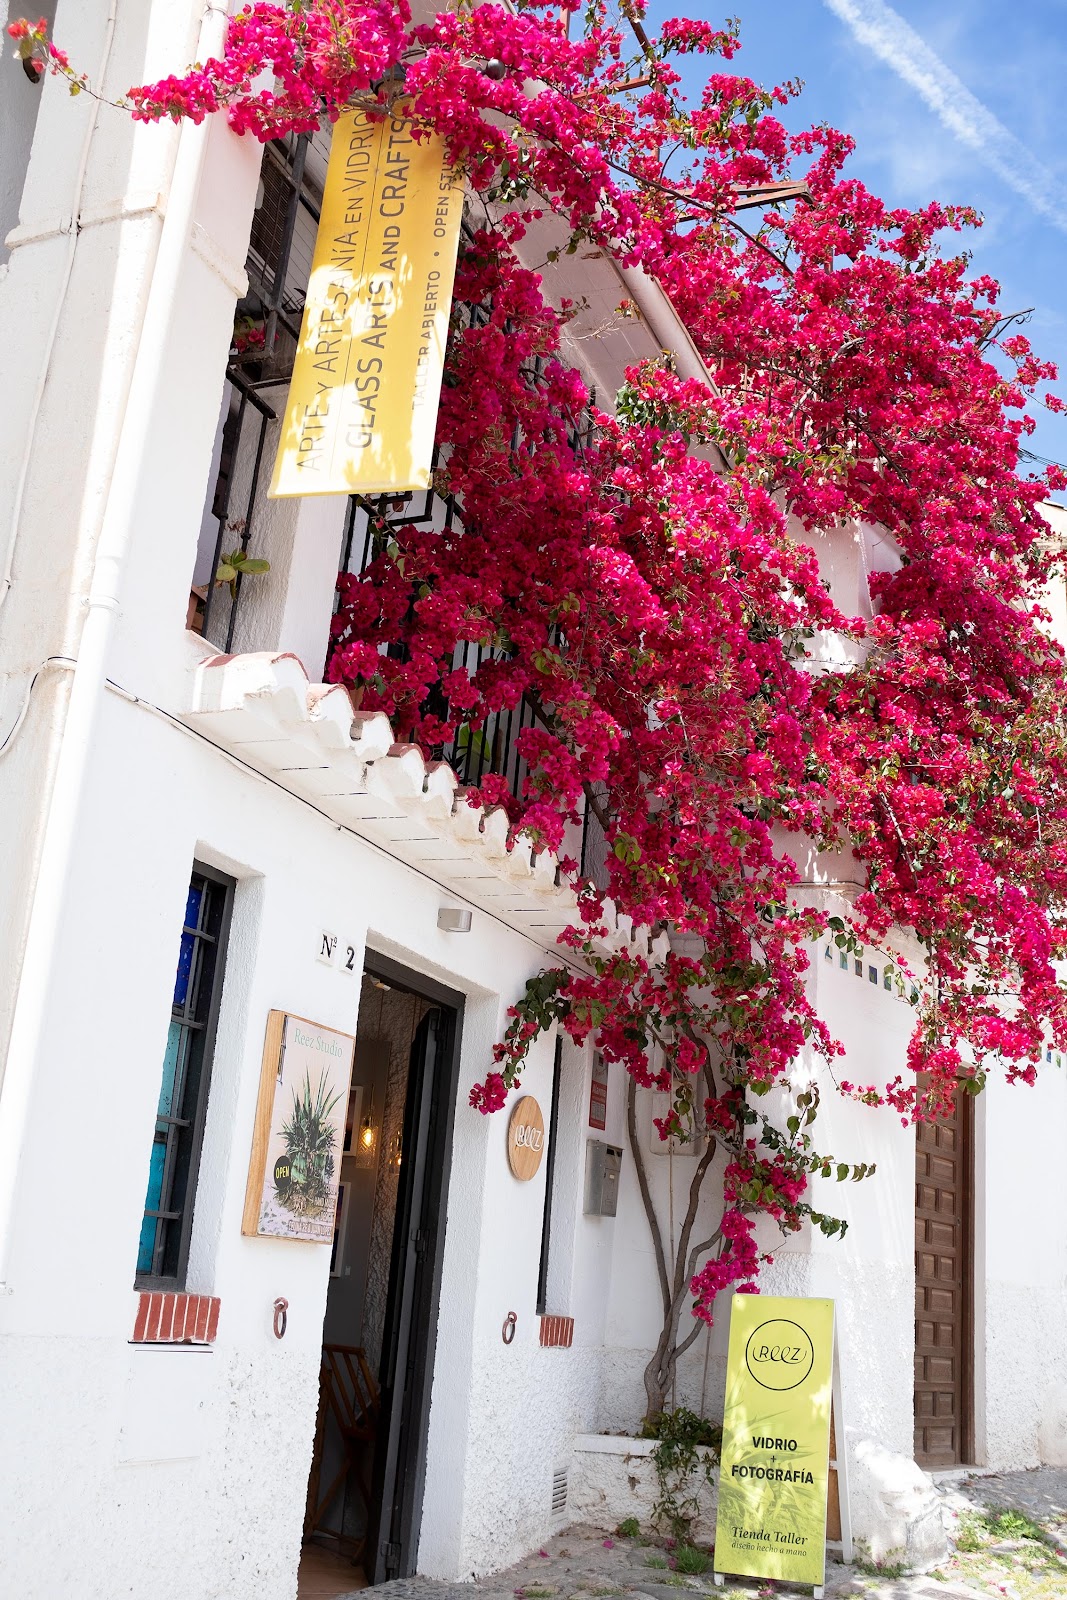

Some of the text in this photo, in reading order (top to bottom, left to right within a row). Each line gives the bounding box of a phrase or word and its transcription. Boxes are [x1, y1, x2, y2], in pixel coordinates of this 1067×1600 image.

[342, 111, 376, 192] VIDRIO
[344, 197, 364, 224] EN
[346, 119, 413, 448] GLASS ARTS AND CRAFTS
[412, 346, 430, 410] TALLER
[421, 271, 441, 339] ABIERTO
[434, 196, 450, 237] OPEN
[316, 381, 334, 395] Y
[296, 404, 330, 471] ARTE
[345, 946, 355, 970] 2
[294, 1028, 343, 1058] Reez Studio
[276, 1166, 290, 1179] OPEN
[752, 1436, 798, 1451] VIDRIO
[731, 1464, 814, 1484] FOTOGRAFÍA
[732, 1526, 808, 1545] Tienda Taller
[731, 1540, 755, 1551] diseño
[757, 1542, 778, 1553] hecho
[785, 1549, 807, 1557] mano
